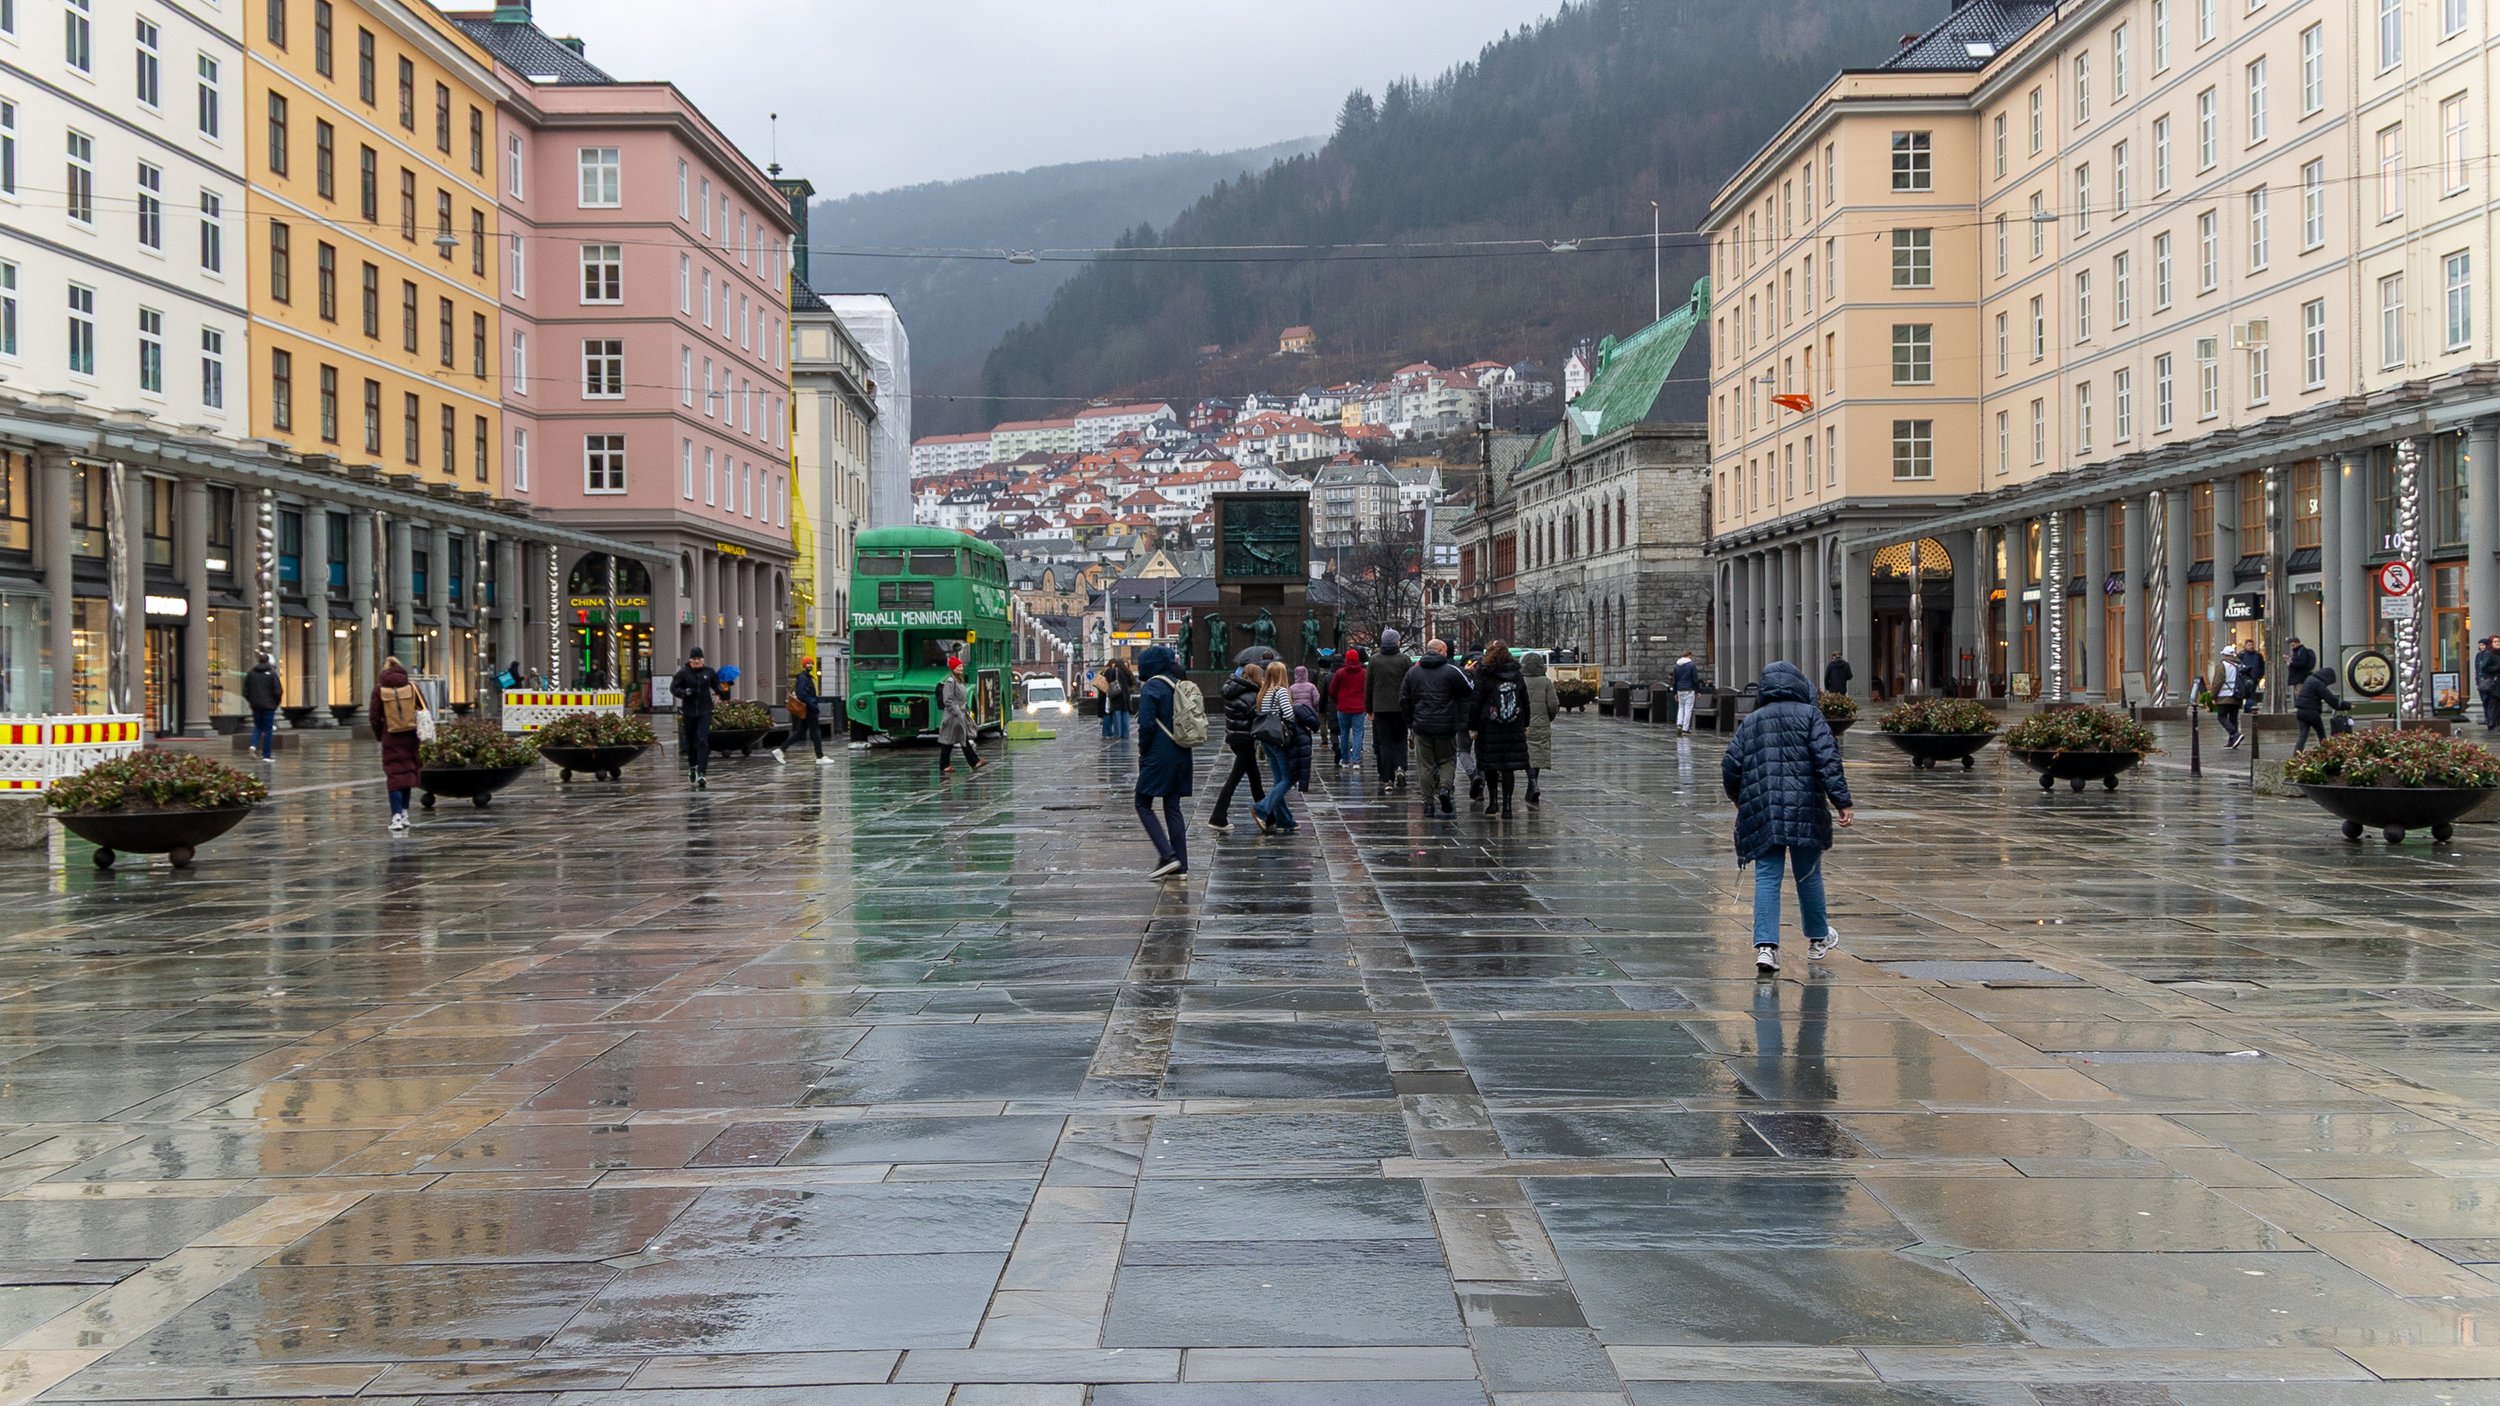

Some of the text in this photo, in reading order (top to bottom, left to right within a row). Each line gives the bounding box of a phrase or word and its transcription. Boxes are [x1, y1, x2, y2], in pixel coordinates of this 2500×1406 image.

[570, 598, 648, 607] CHINA ALACE
[852, 610, 962, 626] TORVALL MENNINGEN
